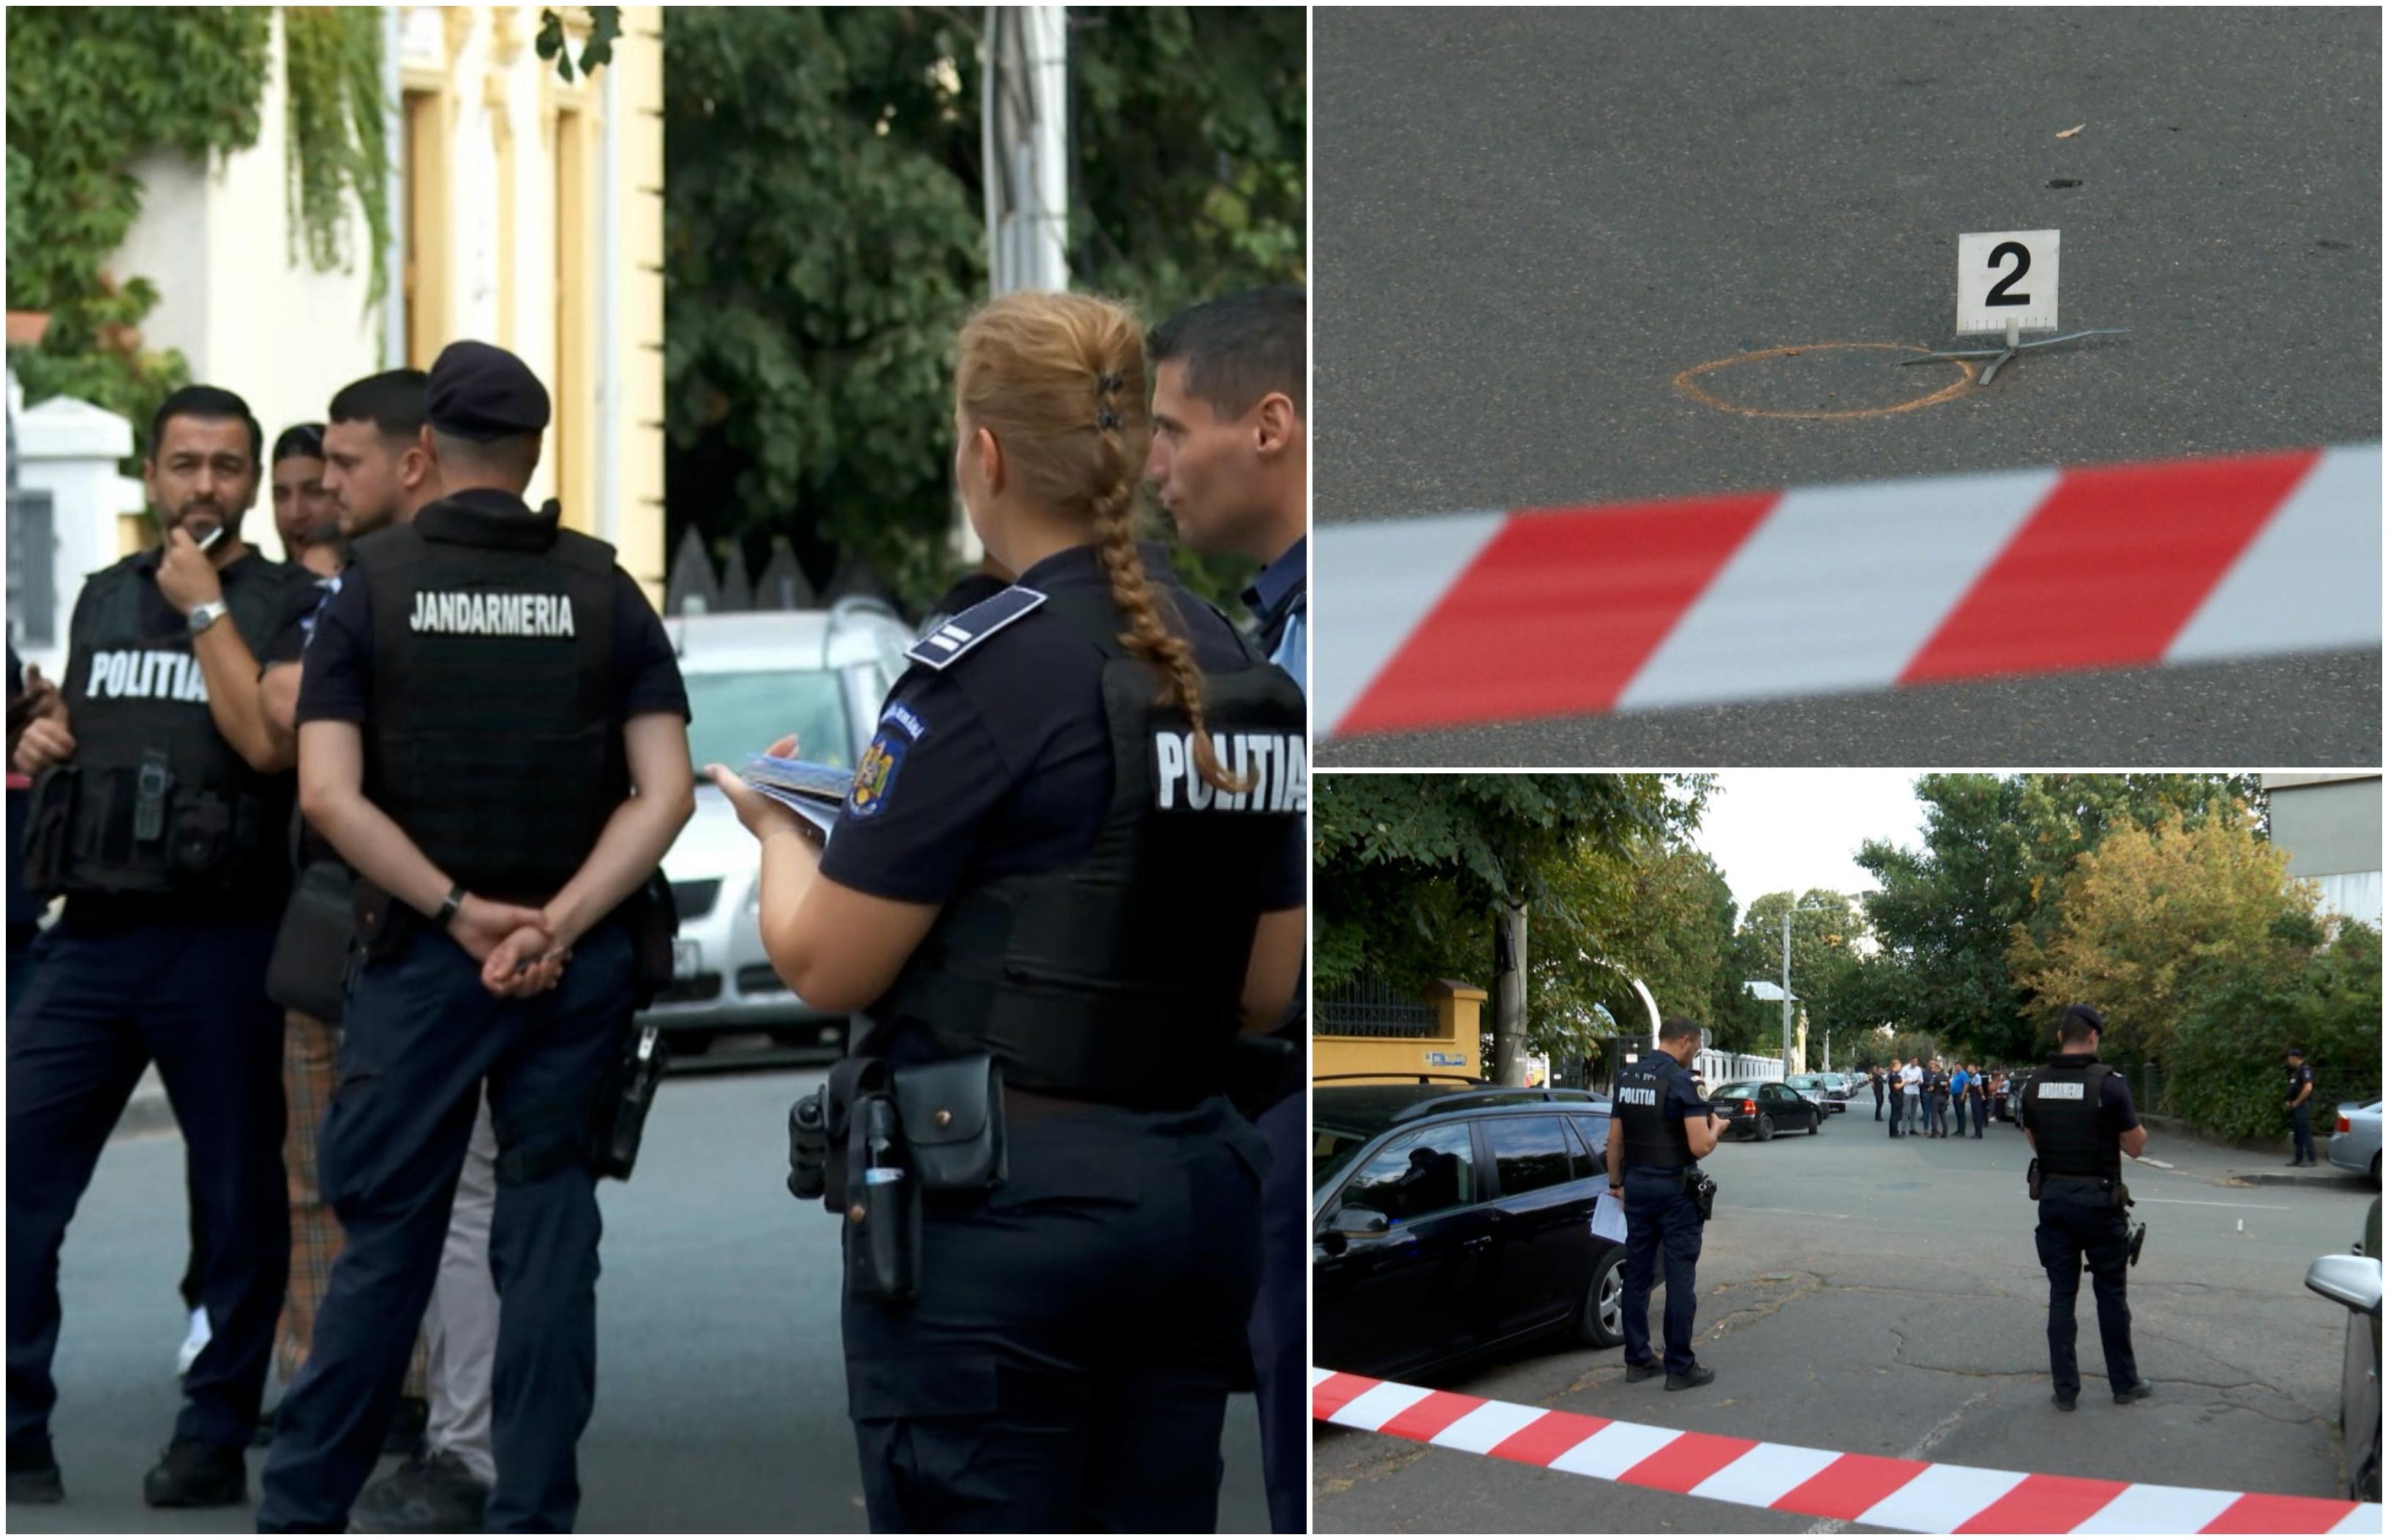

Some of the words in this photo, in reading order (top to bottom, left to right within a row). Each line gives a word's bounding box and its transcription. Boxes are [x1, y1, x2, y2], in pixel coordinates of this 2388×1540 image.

[1985, 241, 2031, 307] 2
[410, 591, 574, 636] JANDARMERIA
[86, 650, 210, 702] POLITIA
[1156, 732, 1307, 811] POLITIA
[1618, 1087, 1656, 1105] POLITIA
